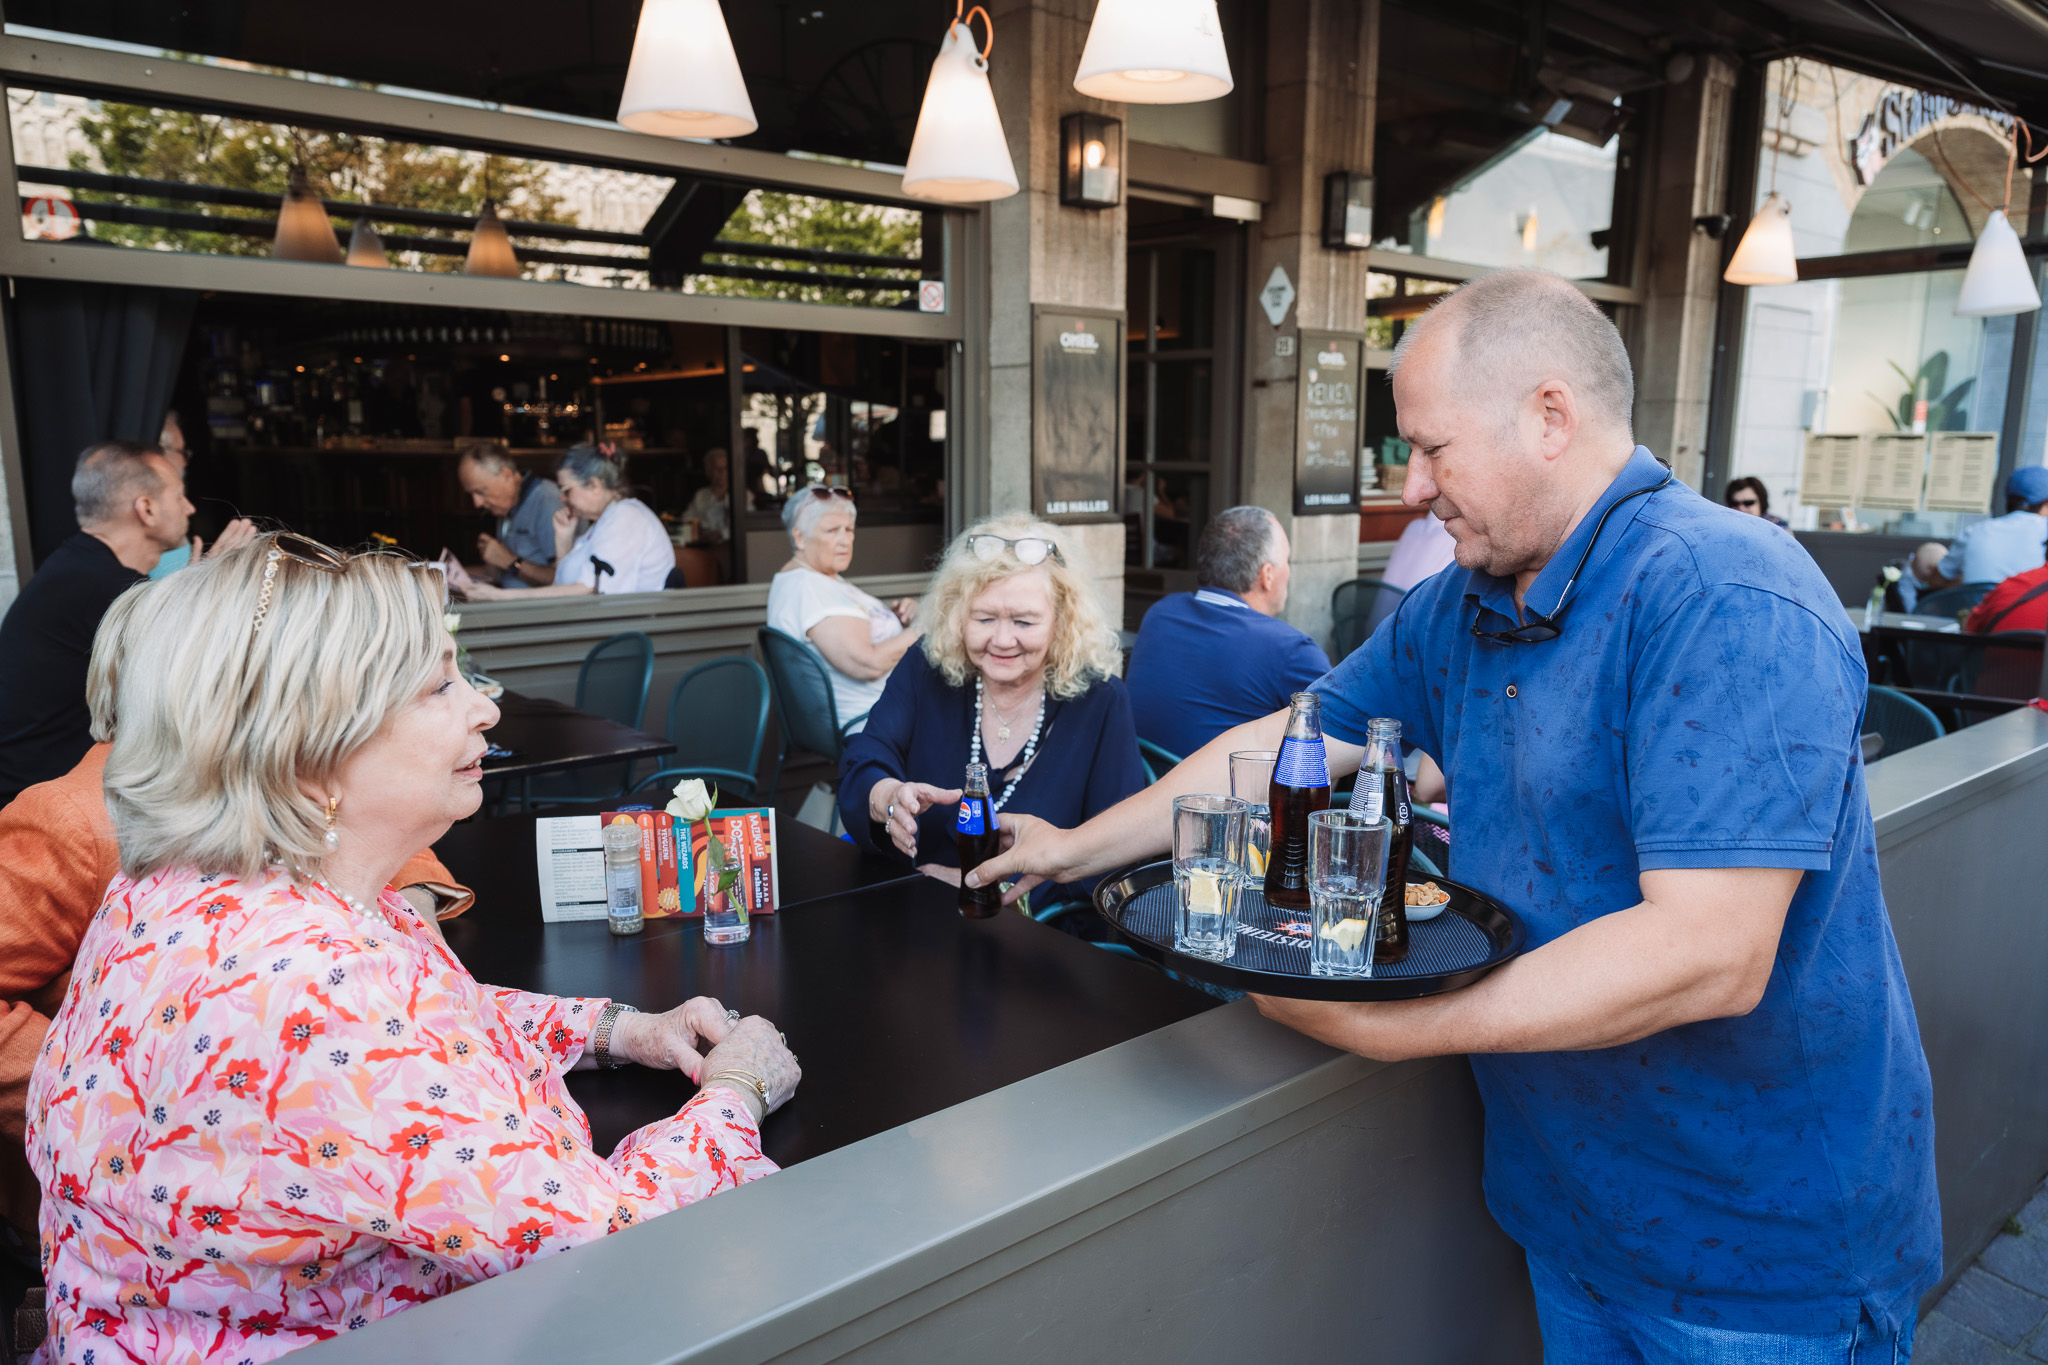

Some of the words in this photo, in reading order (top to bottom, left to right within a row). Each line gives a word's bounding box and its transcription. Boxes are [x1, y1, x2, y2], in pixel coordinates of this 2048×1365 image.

[1046, 501, 1068, 514] LES
[1069, 499, 1109, 513] HALLES
[1304, 494, 1320, 506] LES
[1321, 493, 1351, 505] HALLES
[643, 829, 651, 861] WEGSFEER
[661, 828, 669, 860] YEVGUENI
[749, 814, 765, 858] MUZIKALE
[762, 873, 768, 881] 15
